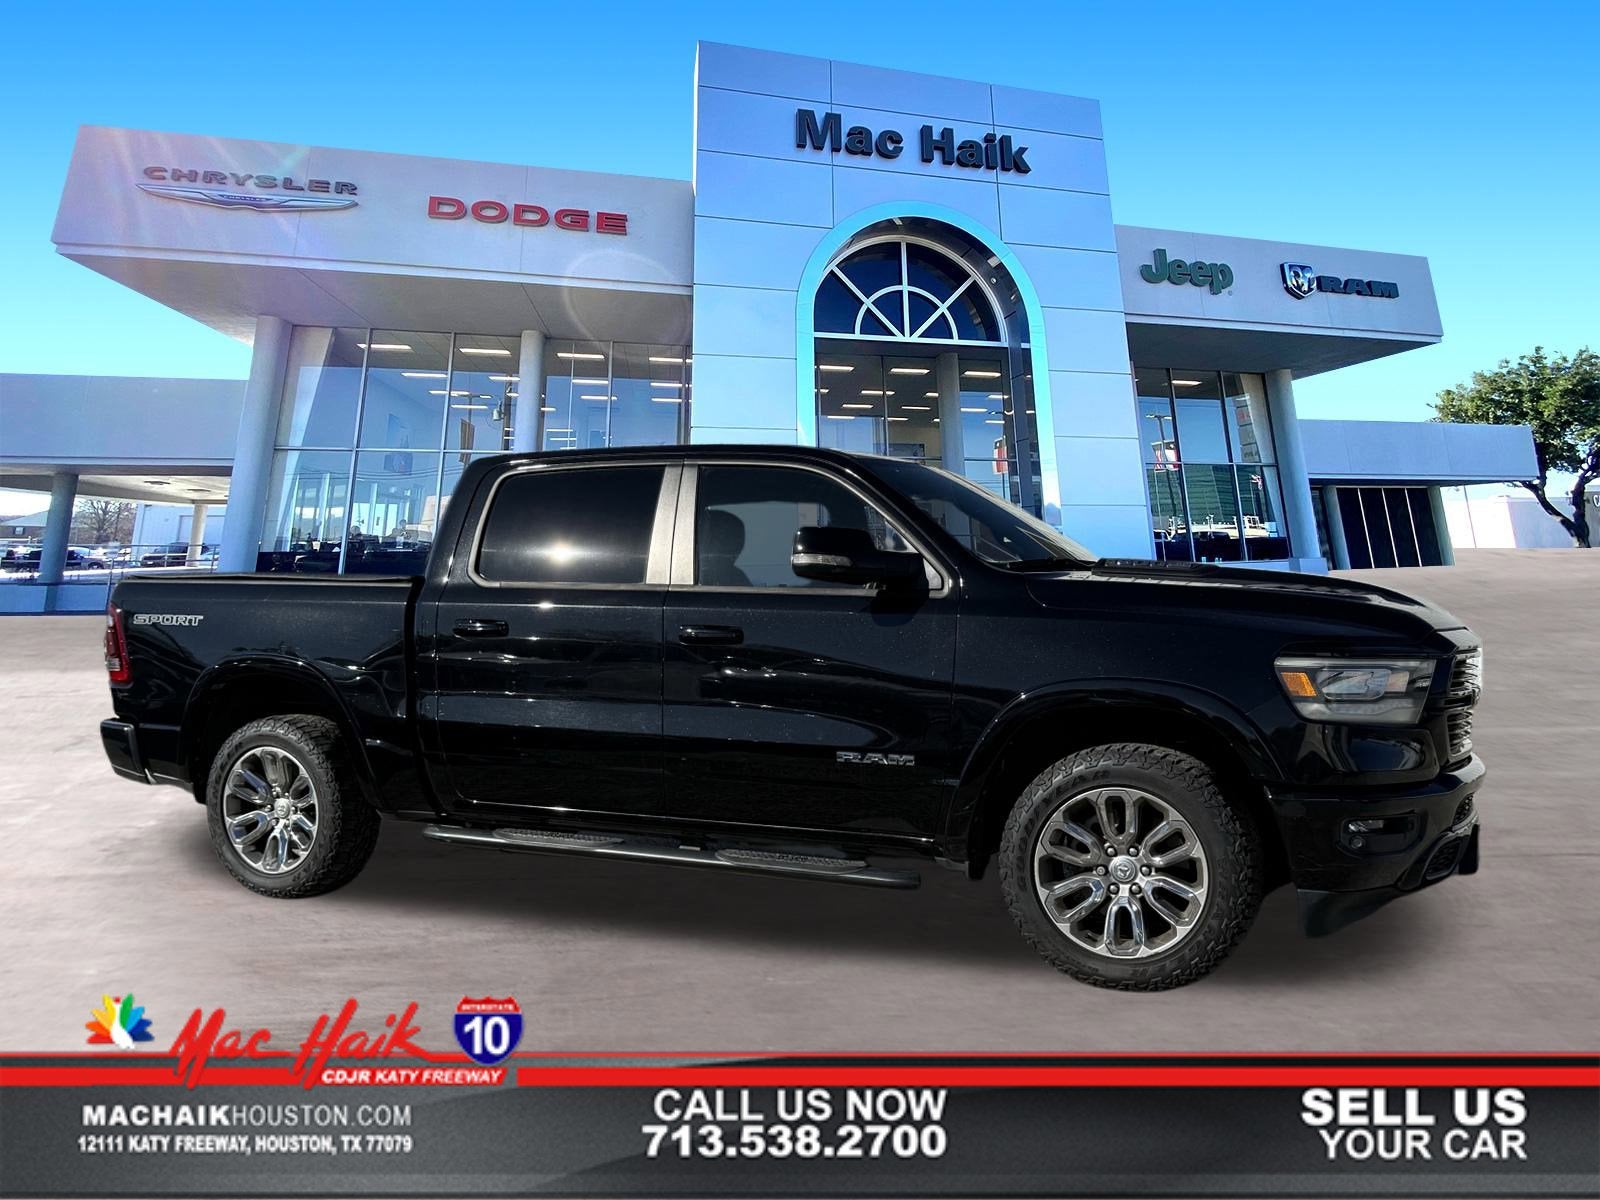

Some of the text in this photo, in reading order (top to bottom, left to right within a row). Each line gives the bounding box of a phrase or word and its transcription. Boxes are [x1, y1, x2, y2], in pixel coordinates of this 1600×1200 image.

[796, 108, 1032, 175] Mac Haik
[143, 166, 358, 196] CHRYSLER
[428, 196, 628, 236] DODGE
[1140, 249, 1233, 296] Jeep
[1316, 275, 1400, 298] RAM
[133, 613, 204, 626] SPORT
[836, 751, 915, 767] RAM
